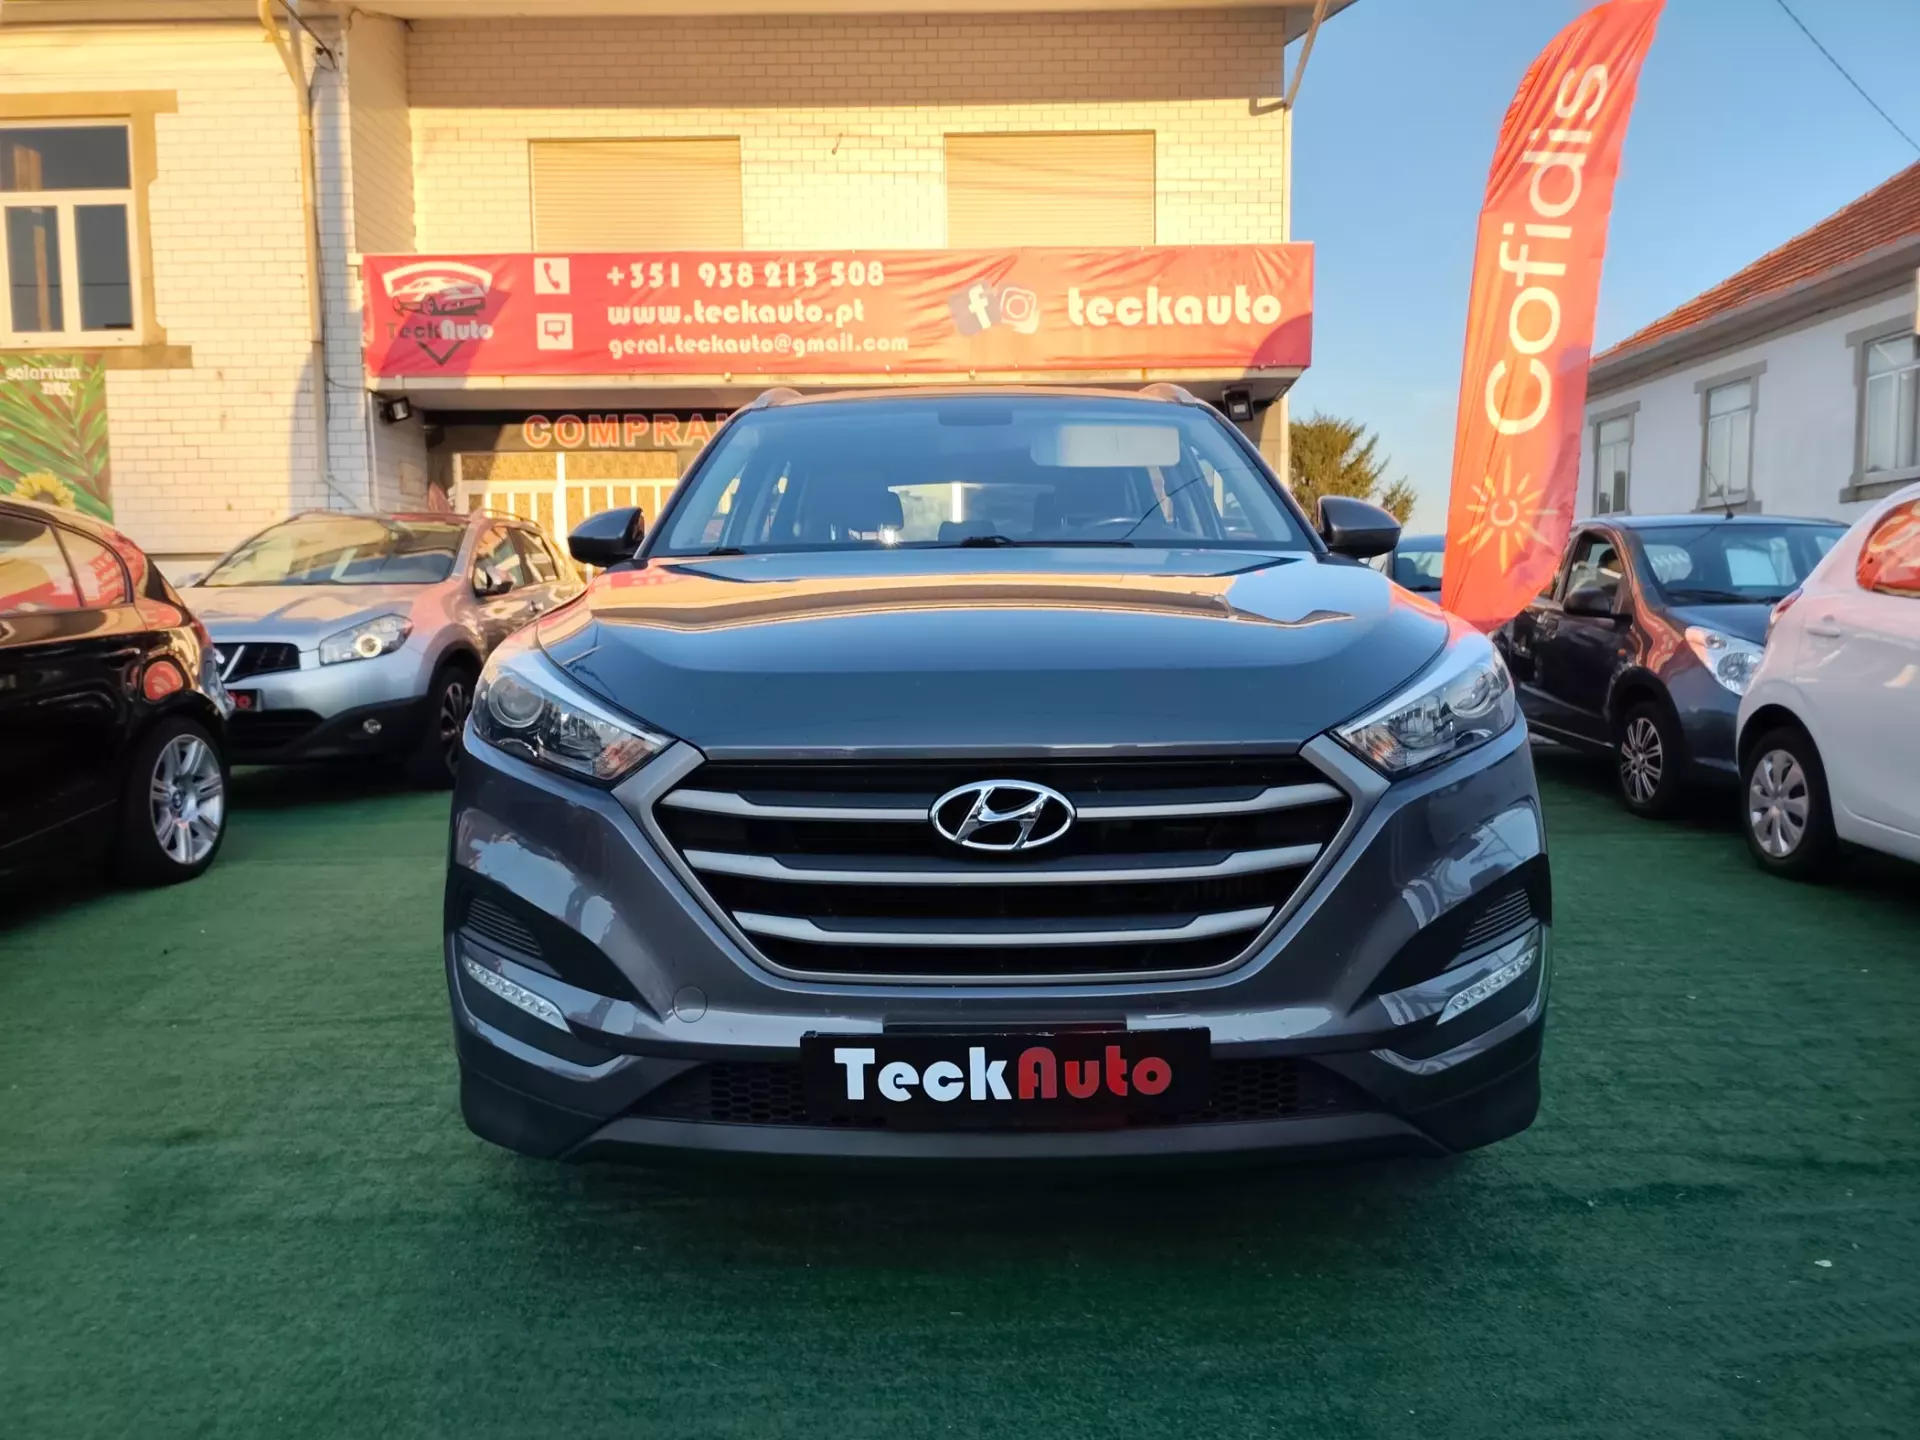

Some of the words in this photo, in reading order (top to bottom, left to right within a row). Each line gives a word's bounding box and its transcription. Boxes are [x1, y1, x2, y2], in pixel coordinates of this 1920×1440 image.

[1484, 63, 1609, 436] Cofidis
[607, 263, 680, 288] +351
[698, 262, 754, 288] 938
[764, 261, 817, 287] 213
[830, 261, 885, 288] 508
[607, 298, 865, 328] www.teckauto.pt
[1067, 285, 1282, 327] teckauto
[384, 319, 494, 341] TeckAuto
[608, 332, 909, 360] geral.teckauto@gmail.com
[833, 1044, 1173, 1102] TeckAuto
